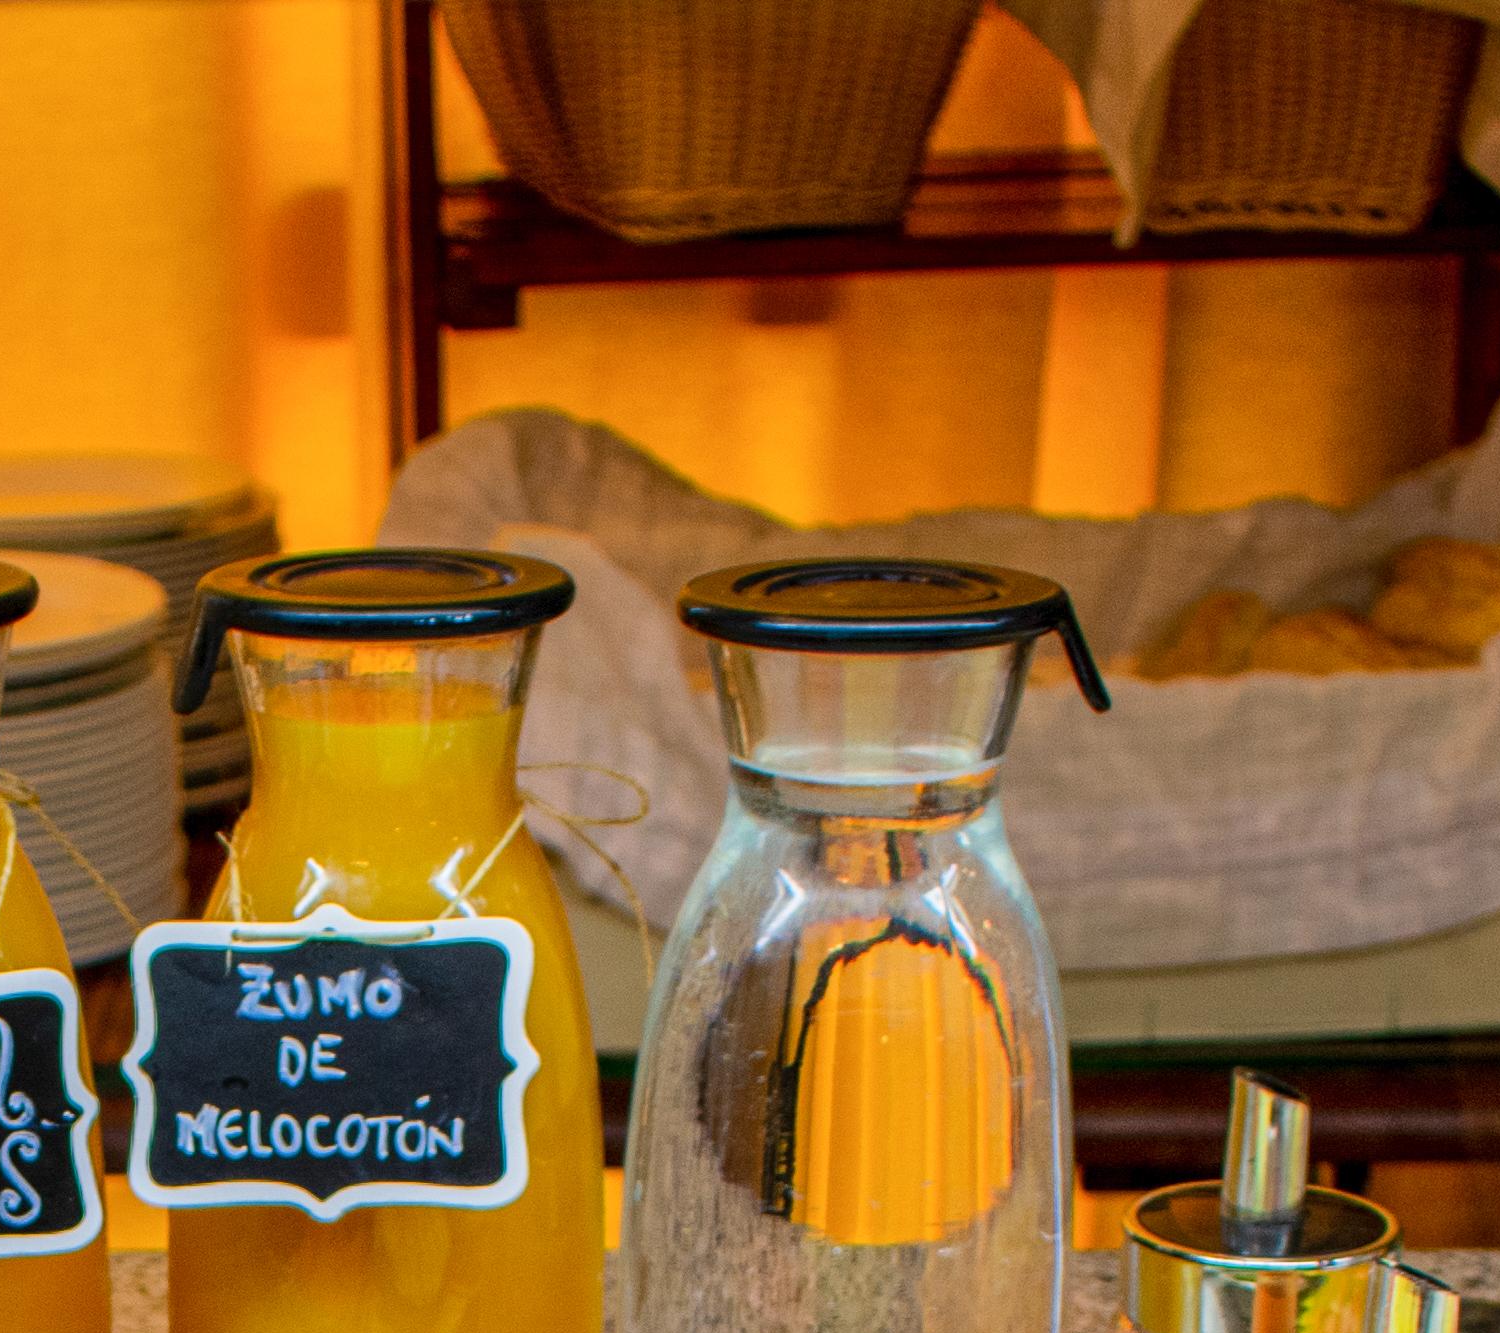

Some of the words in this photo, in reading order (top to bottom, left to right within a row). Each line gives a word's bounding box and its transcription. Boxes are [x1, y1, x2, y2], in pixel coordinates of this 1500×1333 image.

[235, 961, 405, 1021] ZUMO
[277, 1032, 348, 1088] DE
[174, 1093, 467, 1162] MELOCOTÓN
